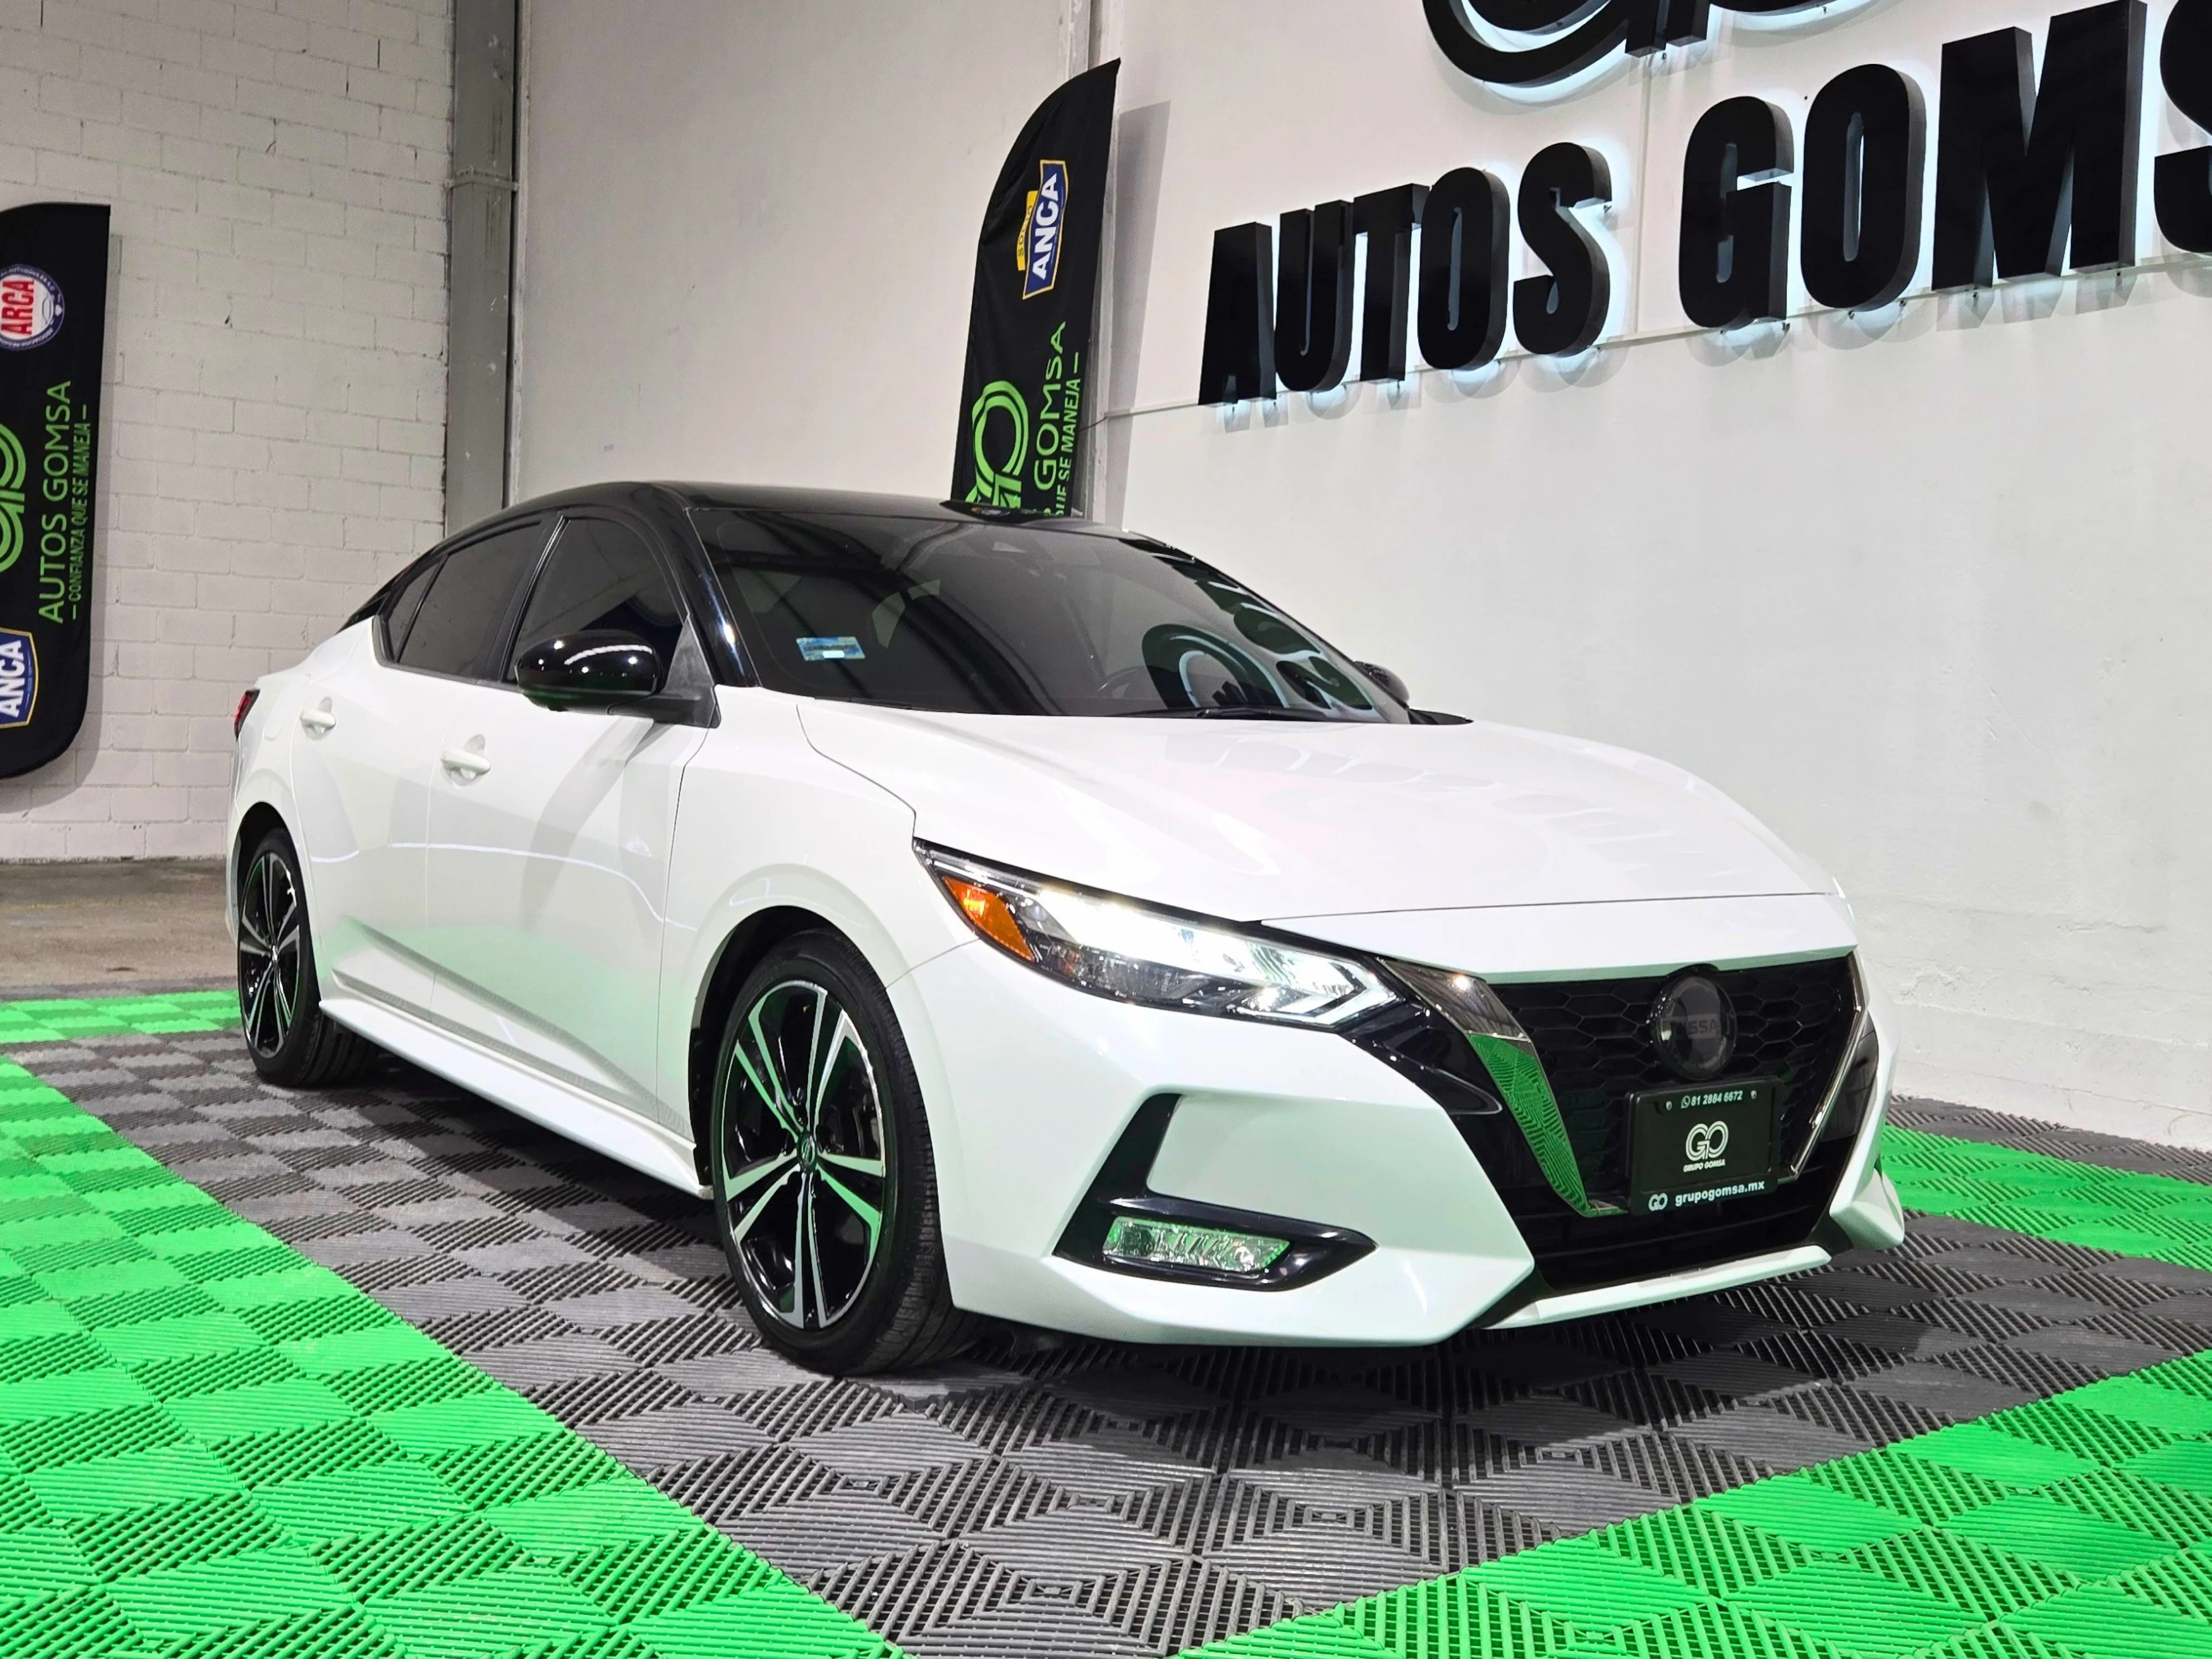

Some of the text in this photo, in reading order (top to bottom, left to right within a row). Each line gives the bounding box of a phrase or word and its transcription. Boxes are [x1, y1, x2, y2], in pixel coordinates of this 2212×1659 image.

[1032, 173, 1059, 280] ANCA
[1, 279, 35, 335] ARCA
[1198, 142, 1613, 407] AUTOS
[1034, 321, 1066, 491] GOMSA
[1061, 378, 1081, 453] MANEJA
[39, 380, 71, 624] AUTOS GOMSA
[1057, 456, 1072, 481] SE
[68, 422, 91, 602] CONFIANZA QUE SE MANEJA
[0, 640, 25, 718] ANCA
[1691, 1090, 1743, 1106] 81 2884 6672
[1675, 1180, 1766, 1207] grupogomsa.mx
